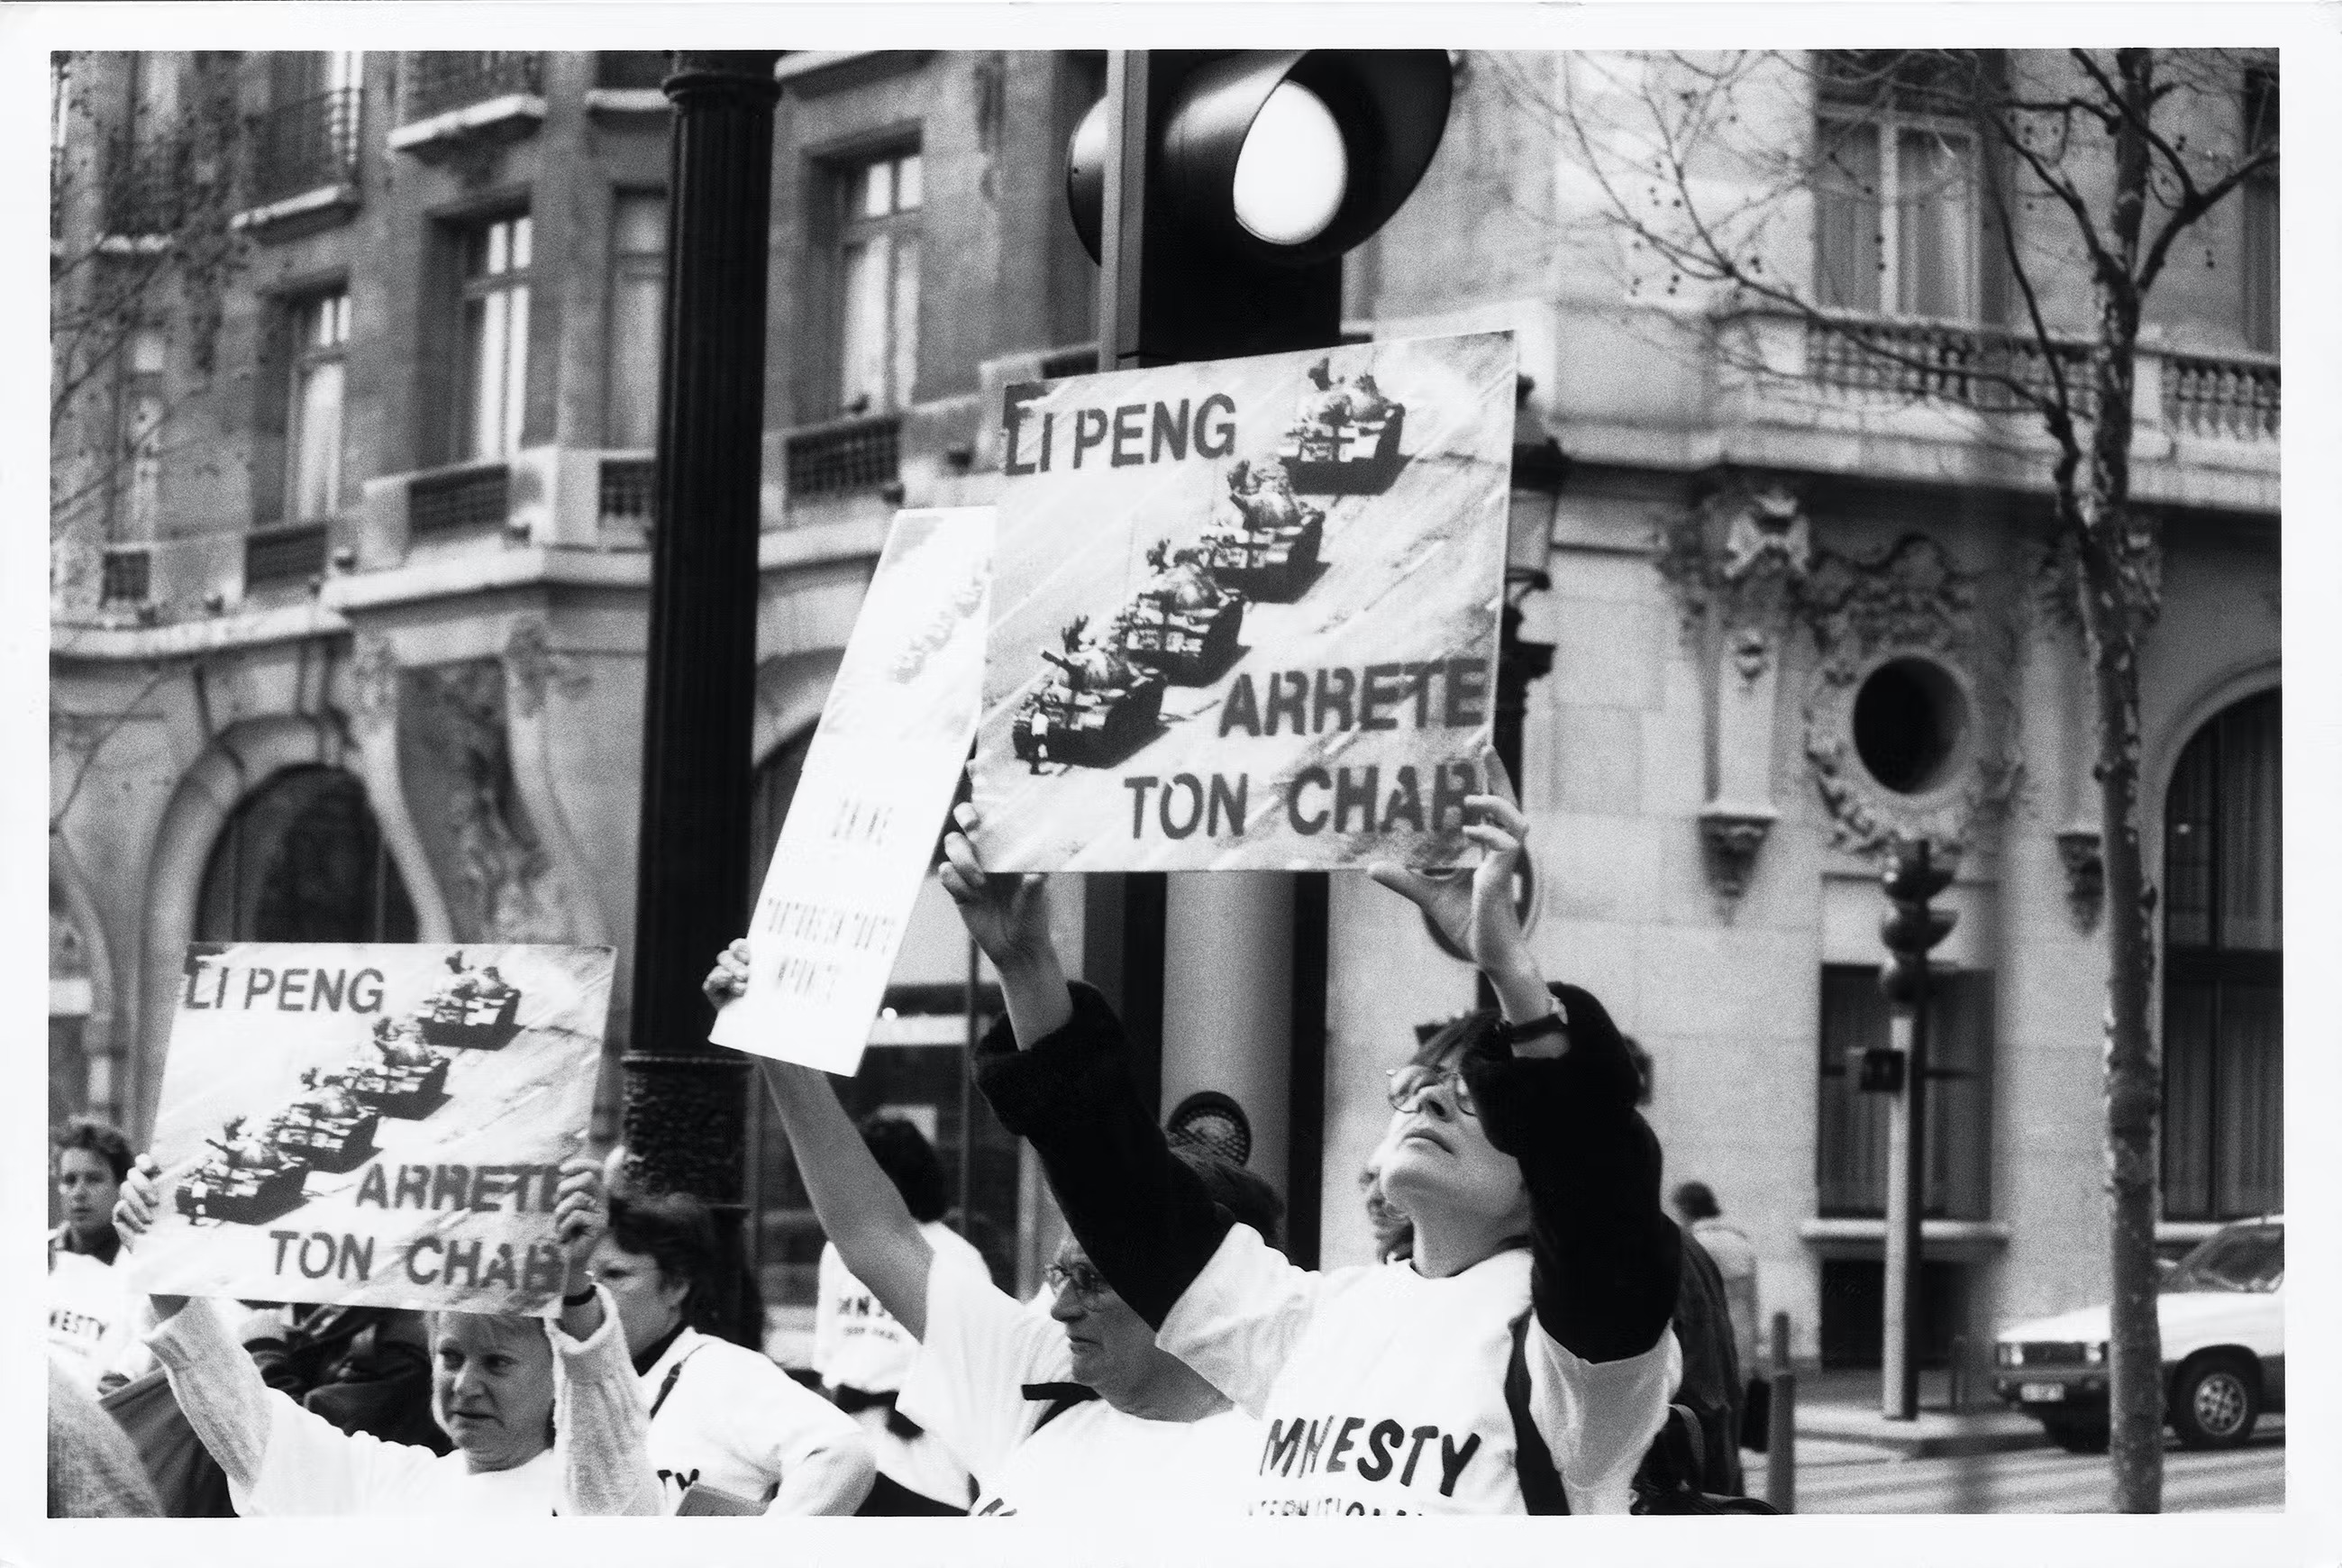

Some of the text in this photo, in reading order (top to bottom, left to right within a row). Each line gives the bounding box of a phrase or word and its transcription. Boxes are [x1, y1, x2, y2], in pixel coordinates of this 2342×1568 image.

[1004, 394, 1235, 476] LI PENG
[1219, 659, 1489, 738] ARRETE
[1124, 772, 1247, 839] TON
[185, 959, 386, 1014] LI PENG
[270, 1231, 374, 1281] TON
